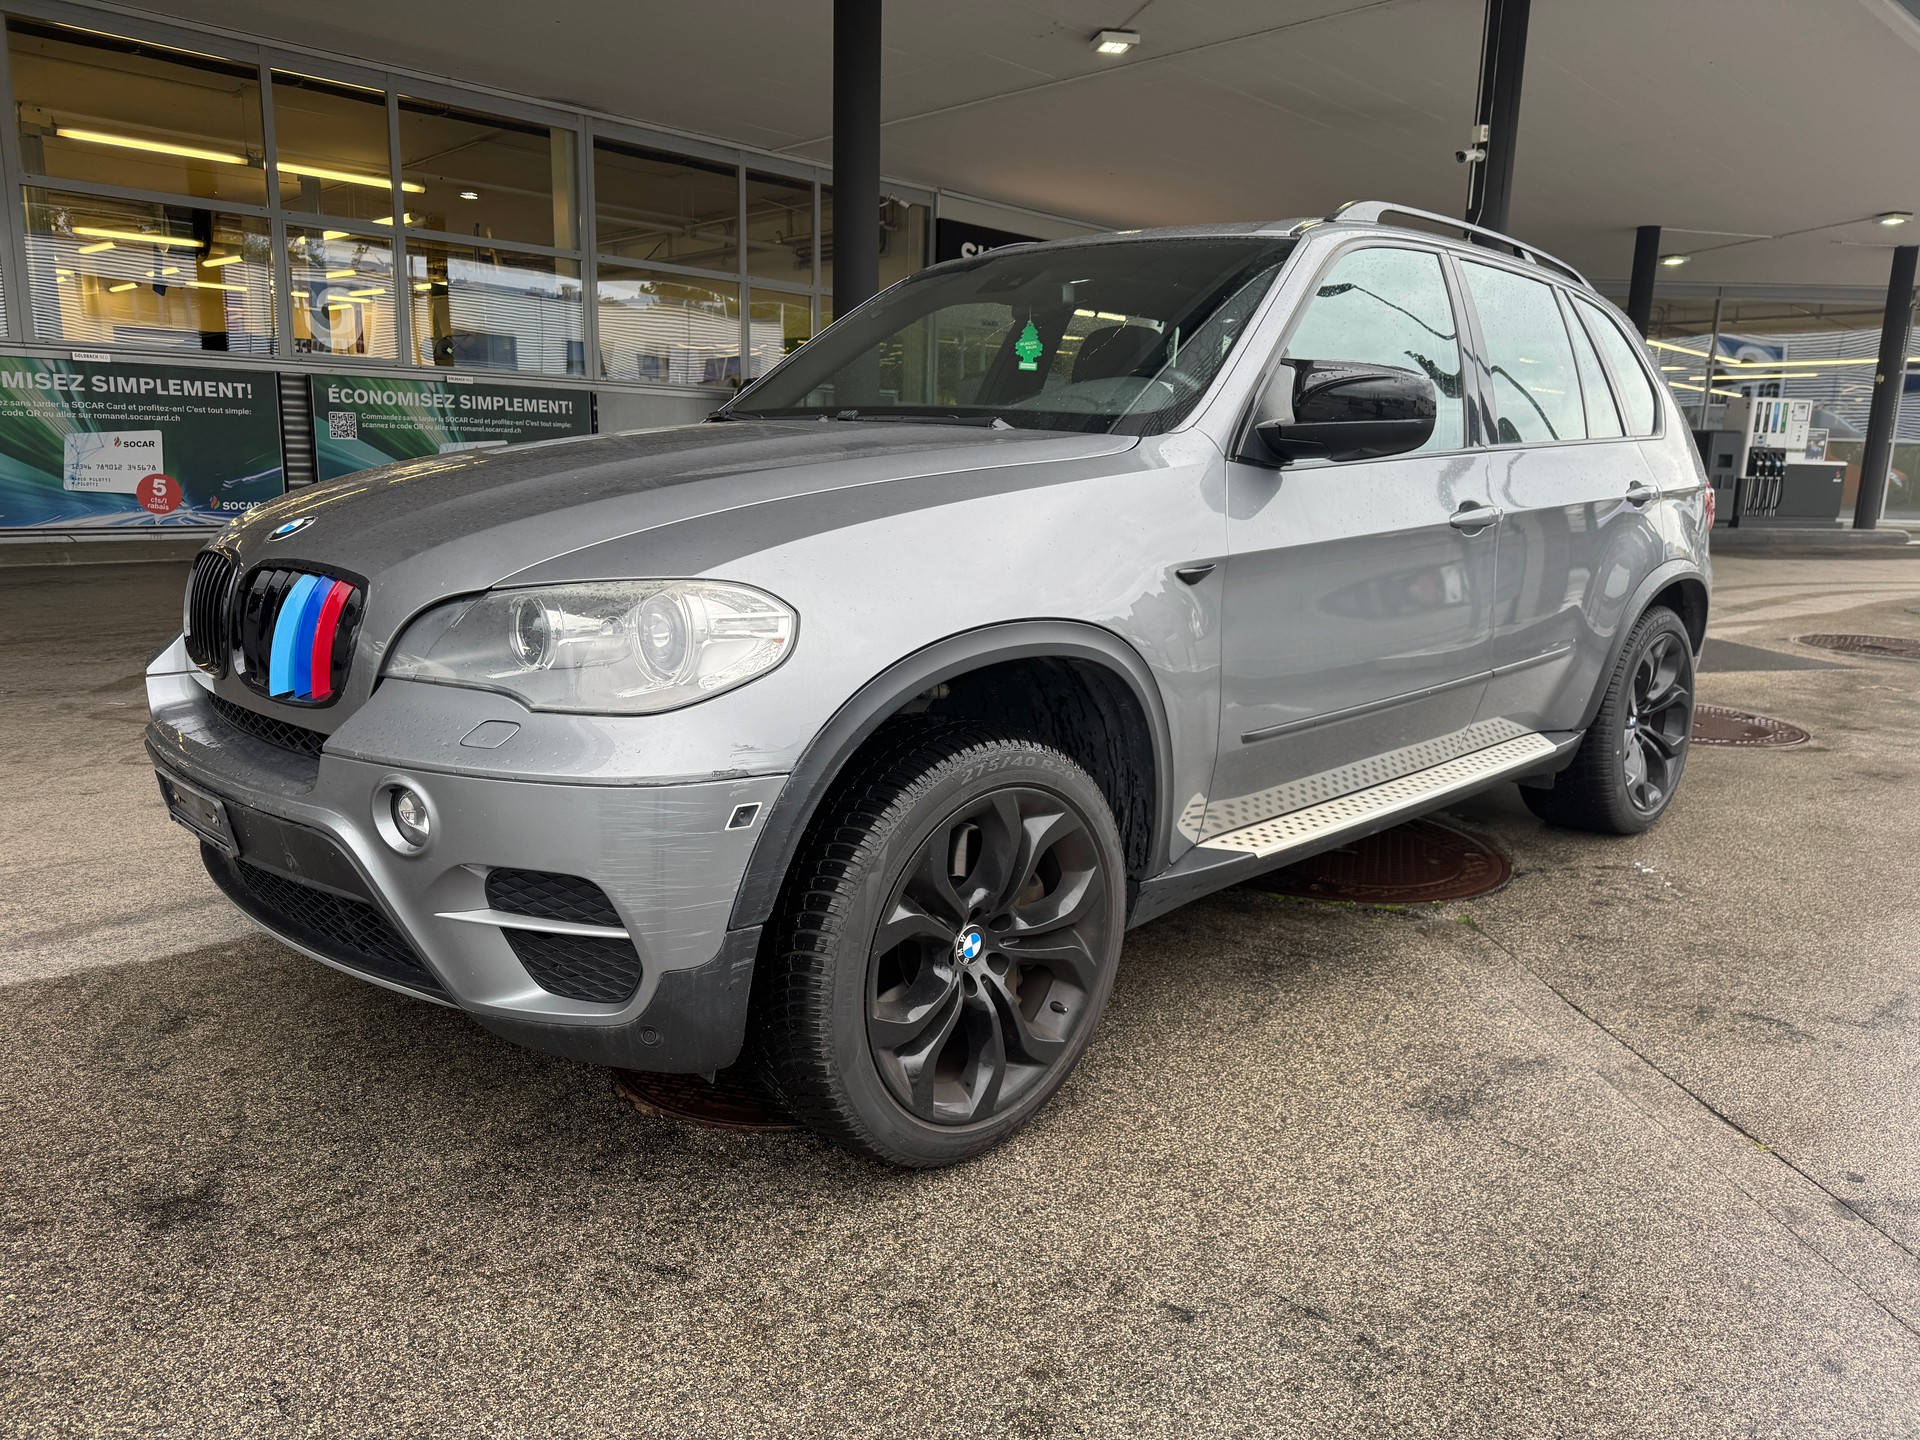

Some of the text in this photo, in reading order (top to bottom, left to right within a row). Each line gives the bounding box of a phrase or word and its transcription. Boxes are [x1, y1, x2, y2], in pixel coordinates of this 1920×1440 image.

[91, 375, 253, 399] SIMPLEMENT!
[328, 384, 573, 415] ÉCONOMISEZ SIMPLEMENT!
[1, 409, 24, 417] code
[25, 409, 41, 418] QR
[56, 410, 77, 418] allez
[93, 412, 181, 422] romanel.socarcard.ch
[10, 400, 33, 408] sans
[33, 400, 60, 408] tarder
[61, 401, 70, 409] la
[71, 401, 105, 410] SOCAR
[106, 402, 126, 411] Card
[128, 403, 136, 411] et
[138, 404, 185, 413] profitez-en!
[186, 405, 206, 414] C'est
[207, 406, 223, 415] tout
[224, 407, 252, 416] simple:
[361, 412, 402, 421] Commandez
[445, 416, 469, 424] SOCAR
[491, 418, 525, 427] profitez-en!
[525, 419, 540, 427] C'est
[540, 420, 552, 428] tout
[396, 422, 413, 430] code
[123, 440, 155, 448] SOCAR
[152, 478, 167, 497] 5
[147, 503, 170, 511] rabais
[961, 755, 1036, 785] 275/40
[1041, 759, 1075, 780] R20
